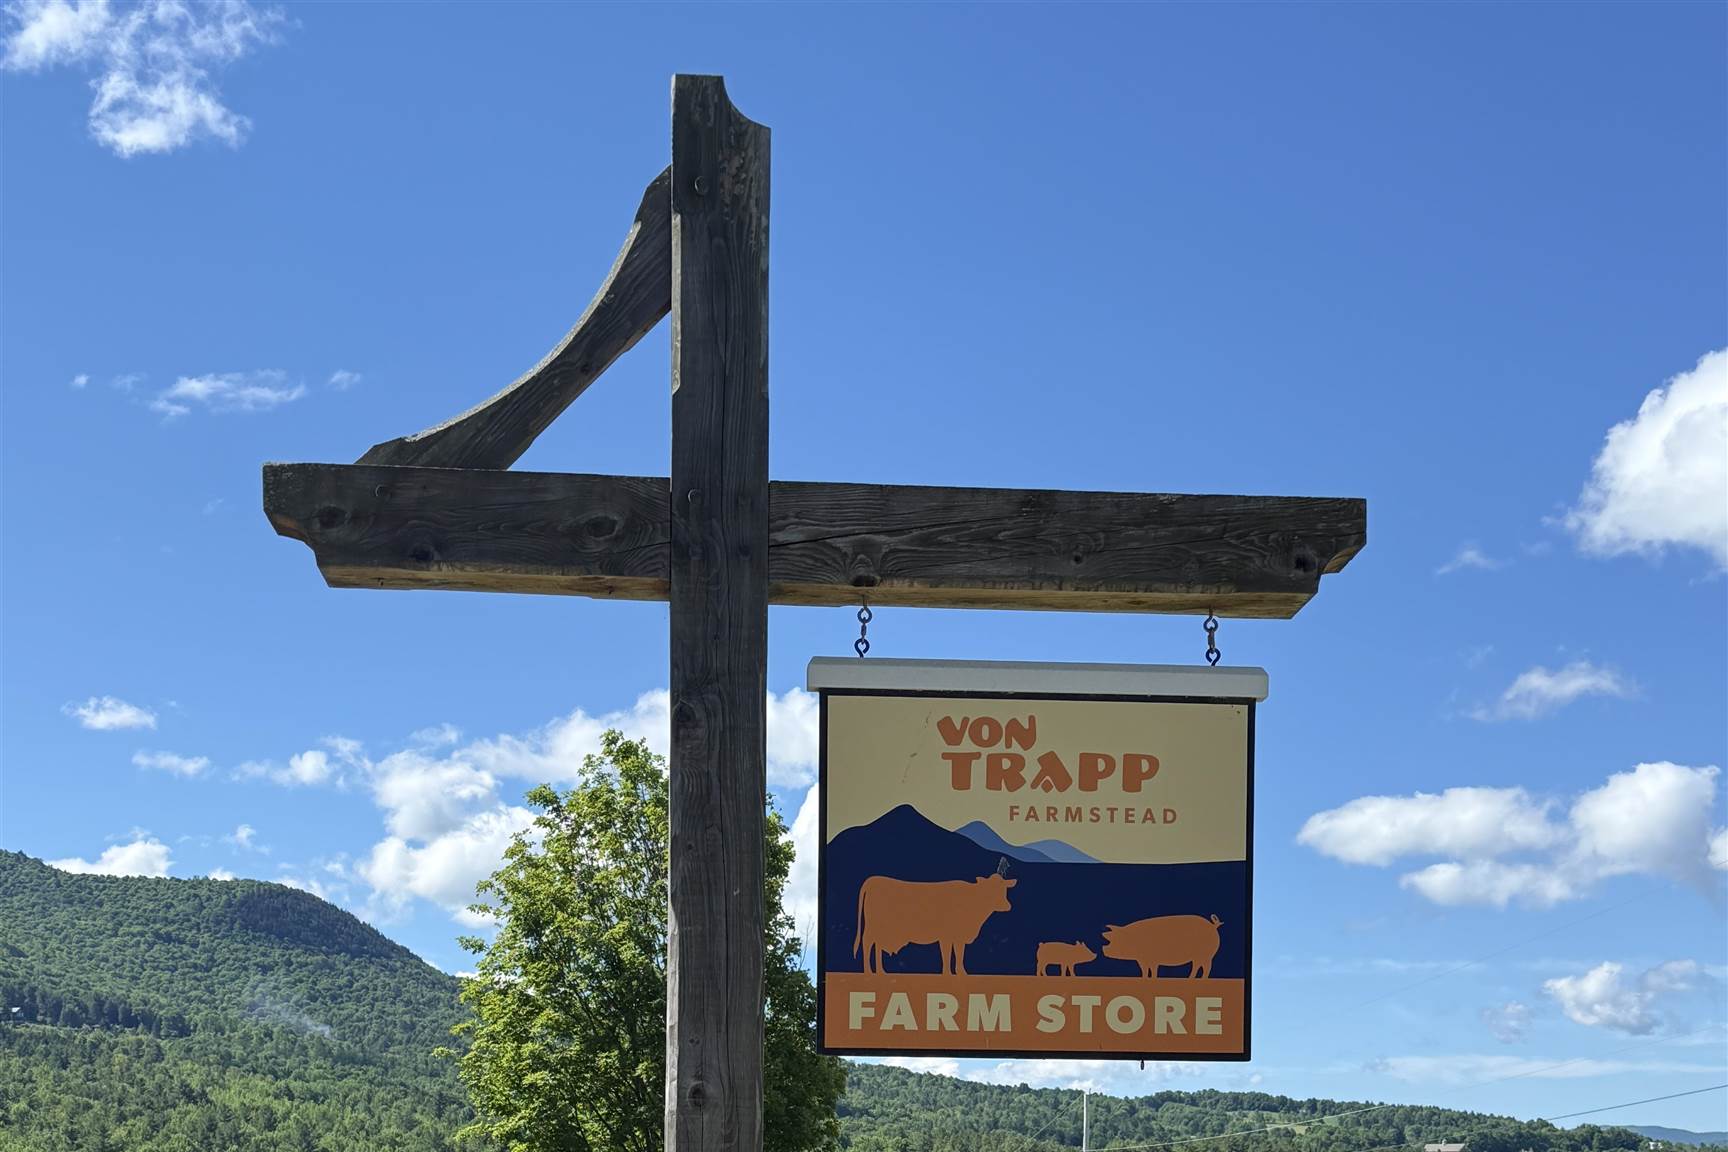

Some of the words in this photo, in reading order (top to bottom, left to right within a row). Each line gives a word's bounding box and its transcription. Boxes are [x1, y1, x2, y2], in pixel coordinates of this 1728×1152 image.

[937, 715, 1037, 751] VON
[941, 751, 1160, 793] TRAPP
[1009, 805, 1178, 825] FARMSTEAD
[848, 991, 1012, 1033] FARM
[1036, 994, 1223, 1035] STORE
